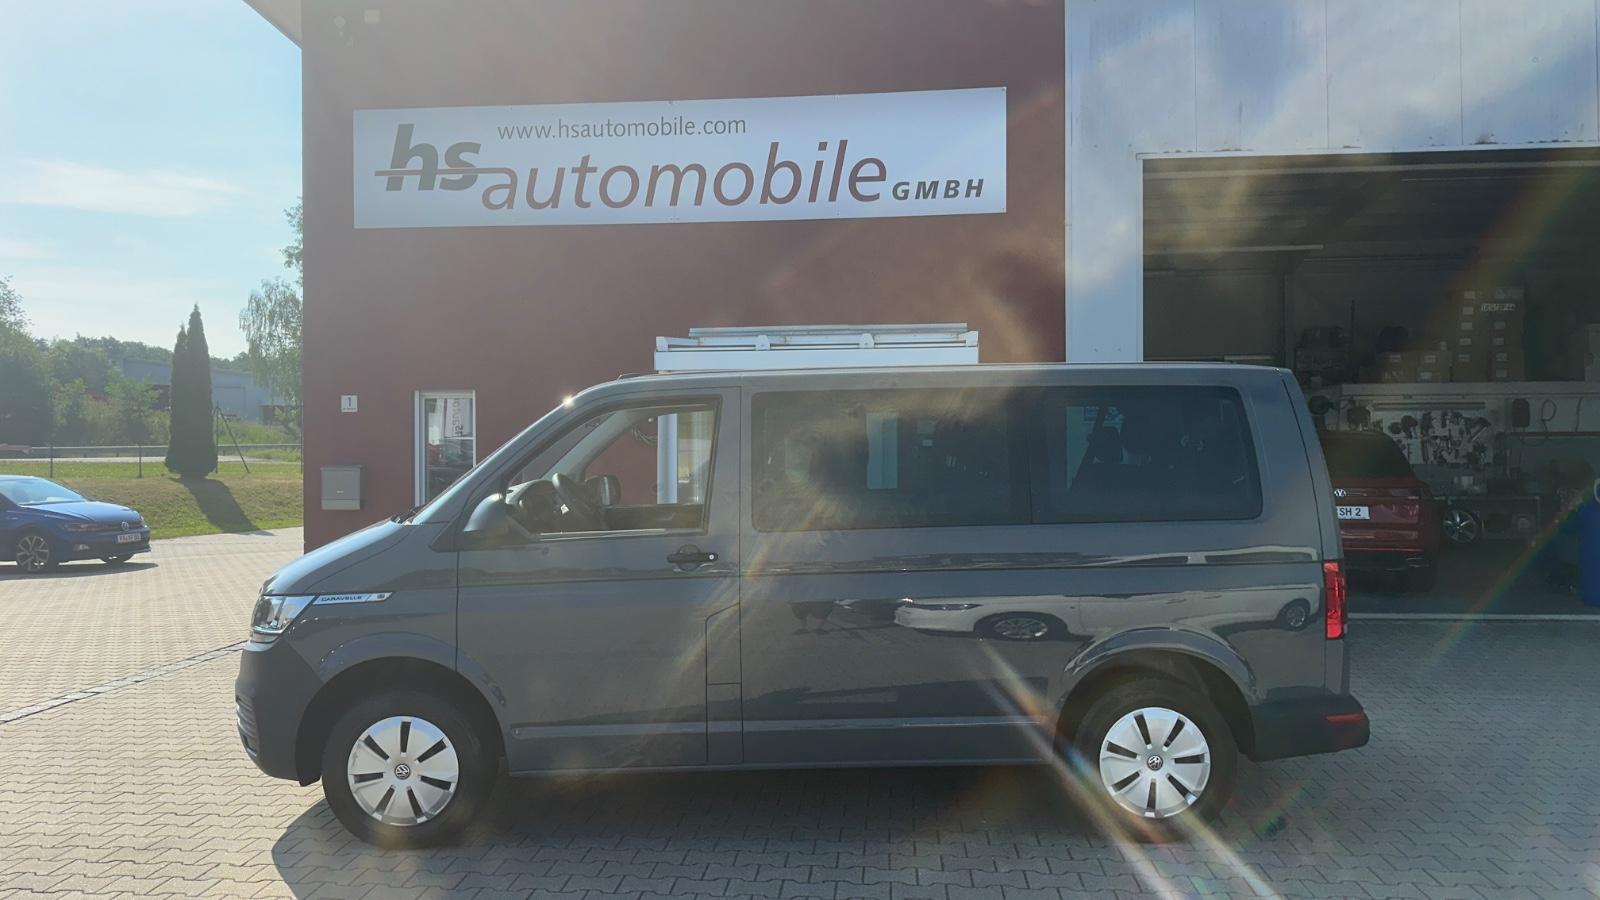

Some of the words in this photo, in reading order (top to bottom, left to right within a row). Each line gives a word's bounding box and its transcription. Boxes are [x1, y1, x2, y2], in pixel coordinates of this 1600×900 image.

[498, 116, 746, 139] www.hsautomobile.com
[386, 123, 482, 191] hs
[481, 139, 887, 210] automobile
[892, 178, 984, 200] GMBH
[1340, 508, 1352, 516] SH
[1355, 507, 1361, 516] 2
